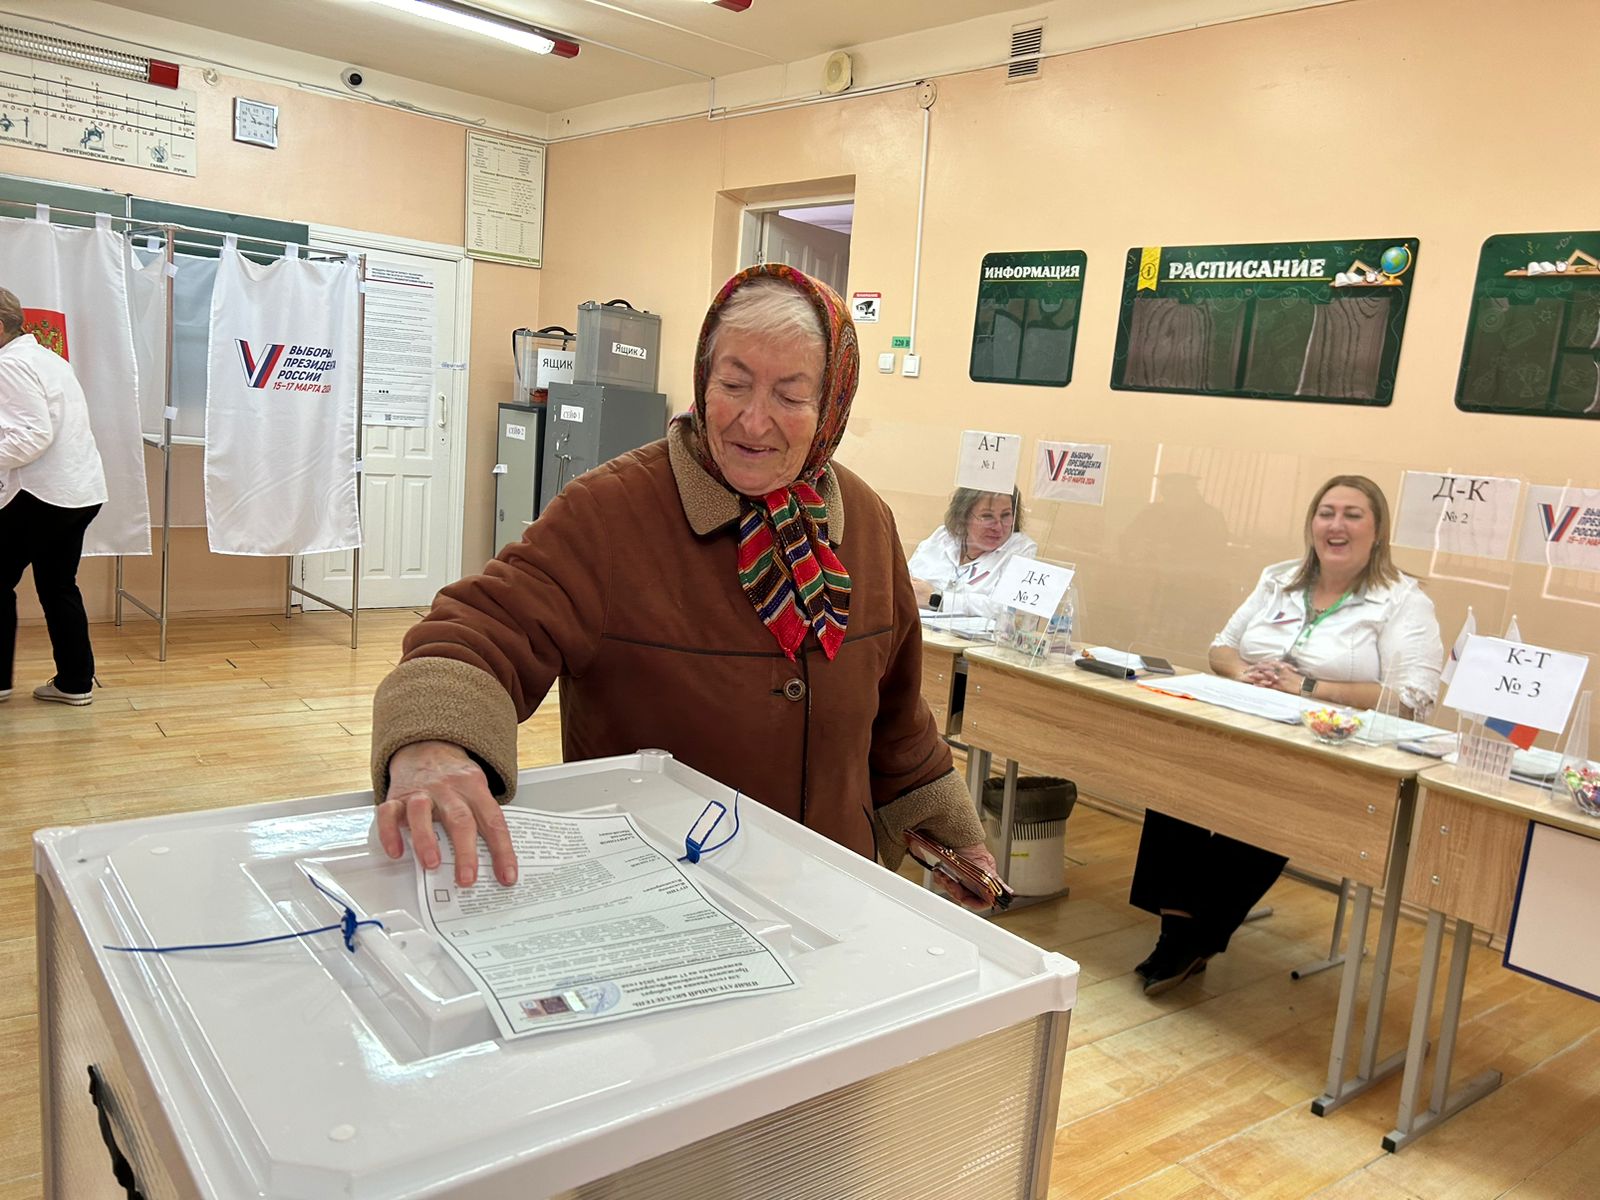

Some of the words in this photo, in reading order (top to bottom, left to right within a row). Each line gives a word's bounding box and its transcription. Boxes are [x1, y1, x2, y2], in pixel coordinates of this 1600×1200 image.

[984, 265, 1080, 280] ИНФОРМАЦИЯ
[1168, 258, 1326, 280] РАСПИСАНИЕ
[289, 345, 335, 359] ВЫБОРЫ
[615, 343, 638, 356] Ящик
[639, 347, 646, 357] 2
[542, 357, 574, 371] ЯЩИК
[277, 369, 323, 382] РОССИИ
[294, 383, 321, 394] МАРТА
[977, 435, 1006, 453] А-Г
[981, 459, 991, 469] №
[991, 460, 996, 470] 1
[1432, 476, 1490, 502] Д-К
[1442, 510, 1458, 523] №
[1460, 513, 1469, 525] 2
[1021, 570, 1050, 587] Д-К
[1013, 589, 1029, 604] №
[1029, 593, 1040, 606] 2
[1507, 647, 1552, 670] К-Т
[1495, 675, 1522, 695] №
[1527, 681, 1542, 698] 3
